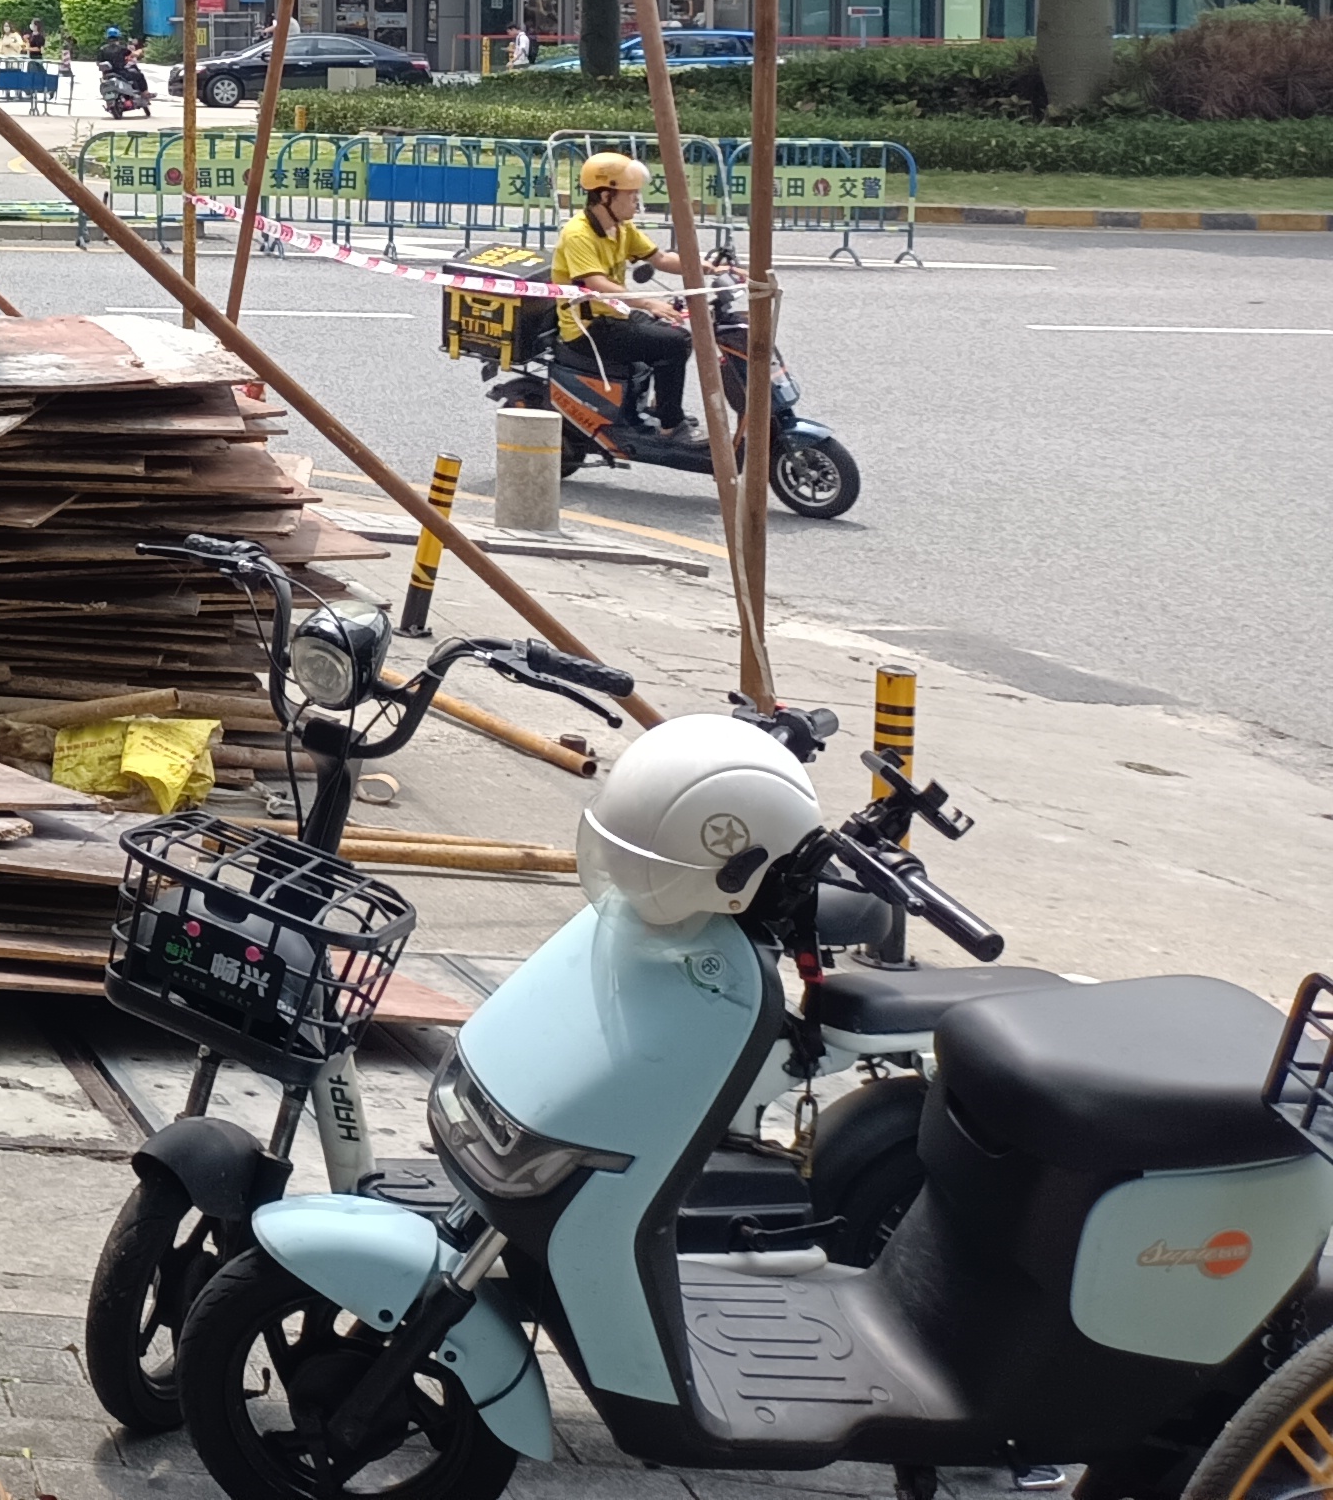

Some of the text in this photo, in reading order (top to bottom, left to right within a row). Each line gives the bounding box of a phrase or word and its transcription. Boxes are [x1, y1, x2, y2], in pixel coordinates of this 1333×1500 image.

[113, 165, 157, 187] 福田
[195, 167, 310, 189] 福田 交警
[313, 168, 357, 190] 福田
[838, 175, 882, 198] 交警
[210, 952, 271, 998] 畅兴
